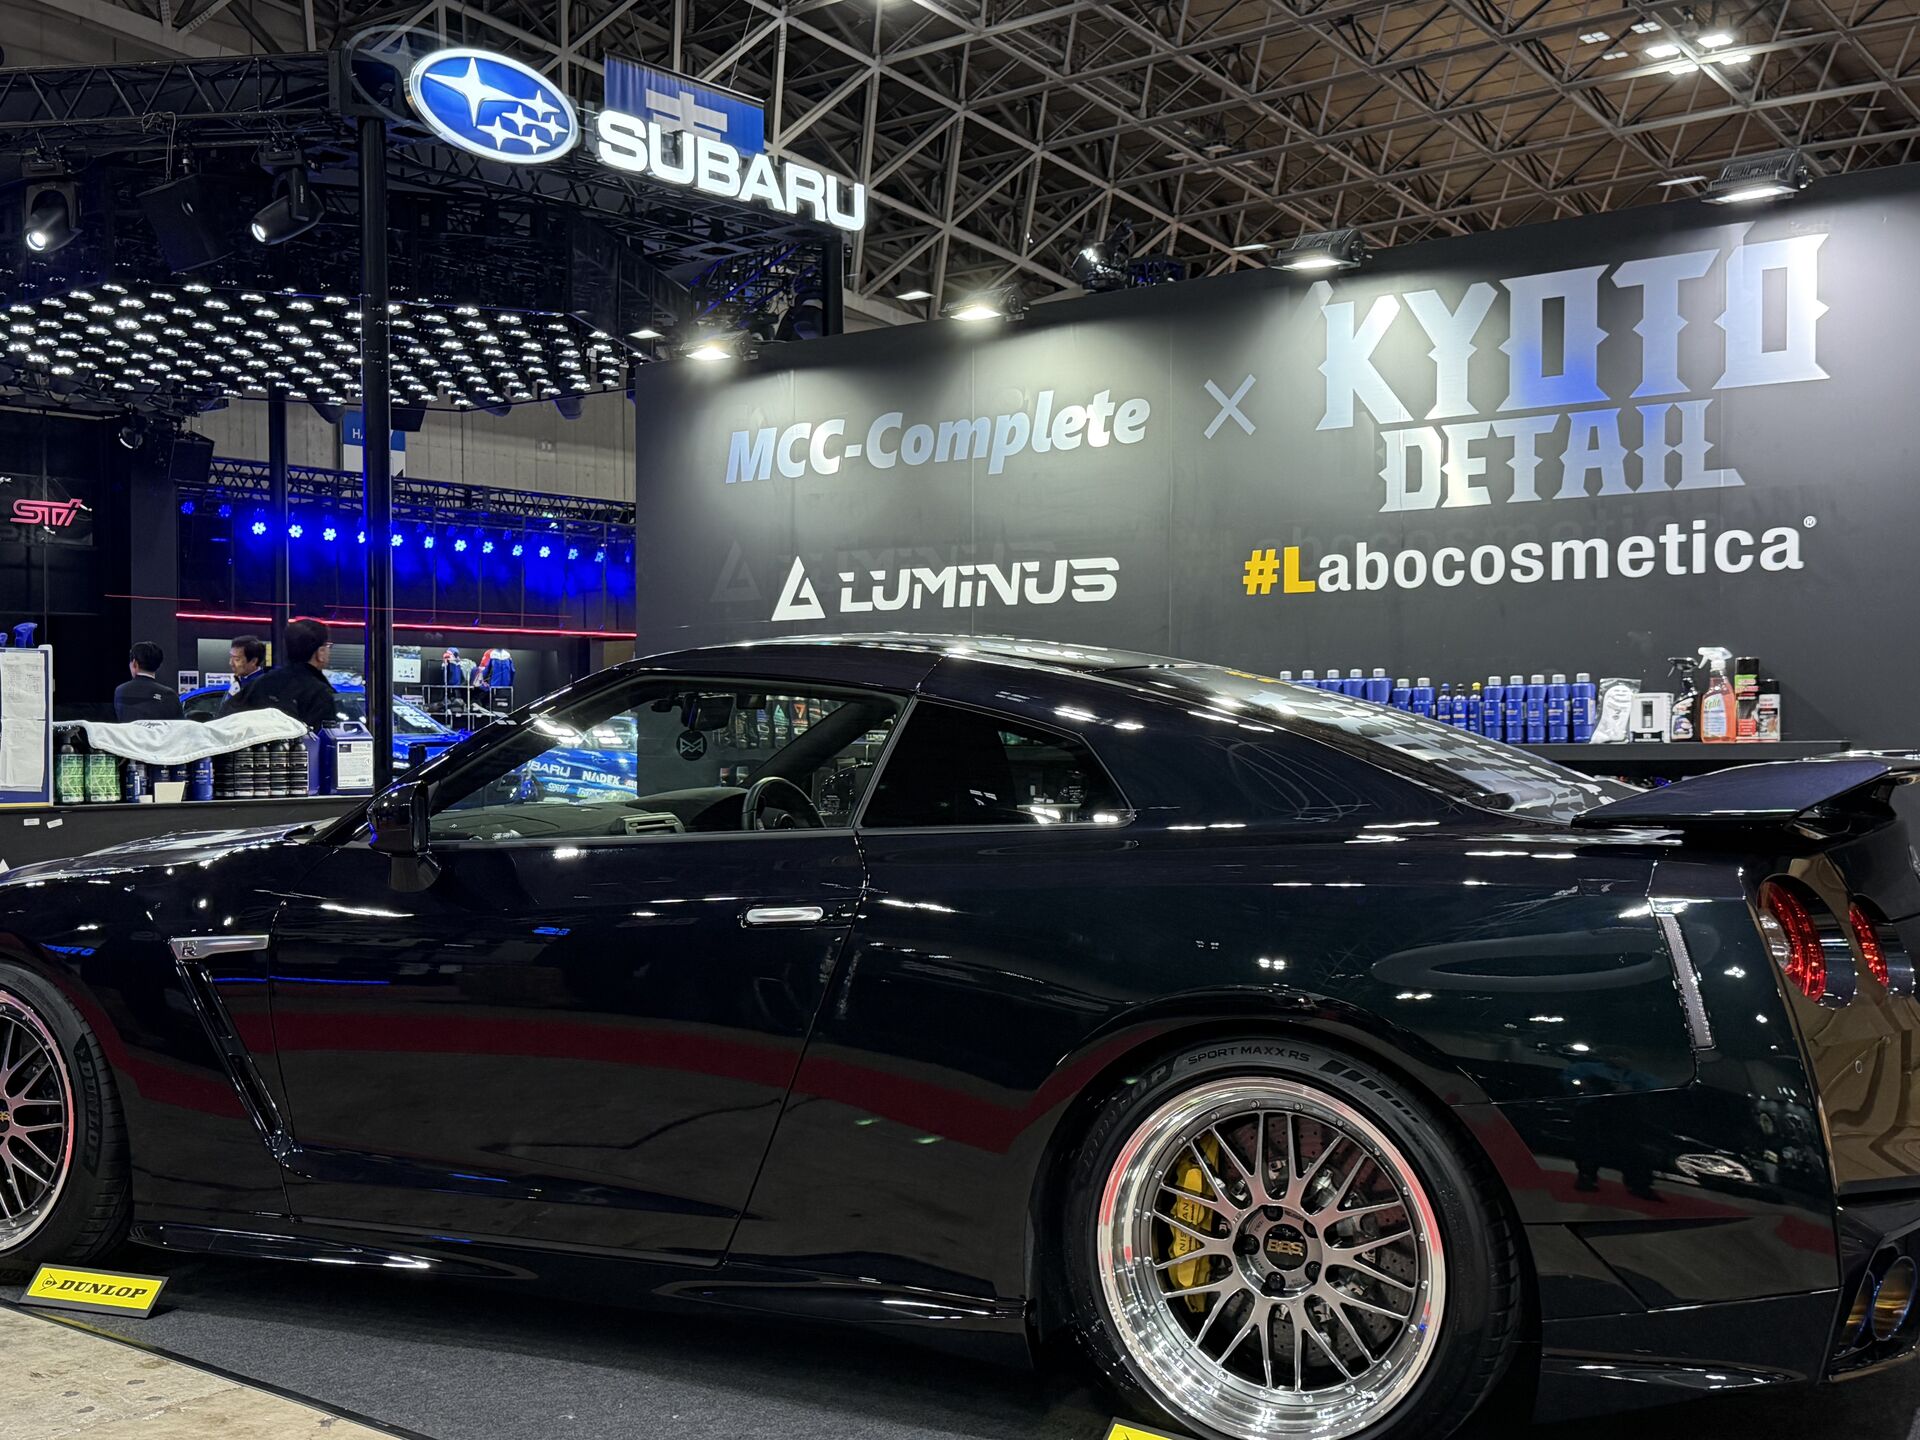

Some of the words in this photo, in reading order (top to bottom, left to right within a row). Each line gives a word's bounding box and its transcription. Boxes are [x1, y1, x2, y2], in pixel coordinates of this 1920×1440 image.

[597, 109, 867, 232] SUBARU
[725, 389, 1152, 485] MCC-Complete
[1316, 232, 1831, 432] KYOTO
[1378, 398, 1747, 513] DETAIL
[1187, 1046, 1239, 1065] SPORT
[1240, 1046, 1286, 1056] MAXX
[1287, 1048, 1311, 1063] RS
[1179, 1202, 1189, 1252] NISAN
[1266, 1238, 1304, 1257] BBS
[58, 1279, 148, 1299] DUNLOP
